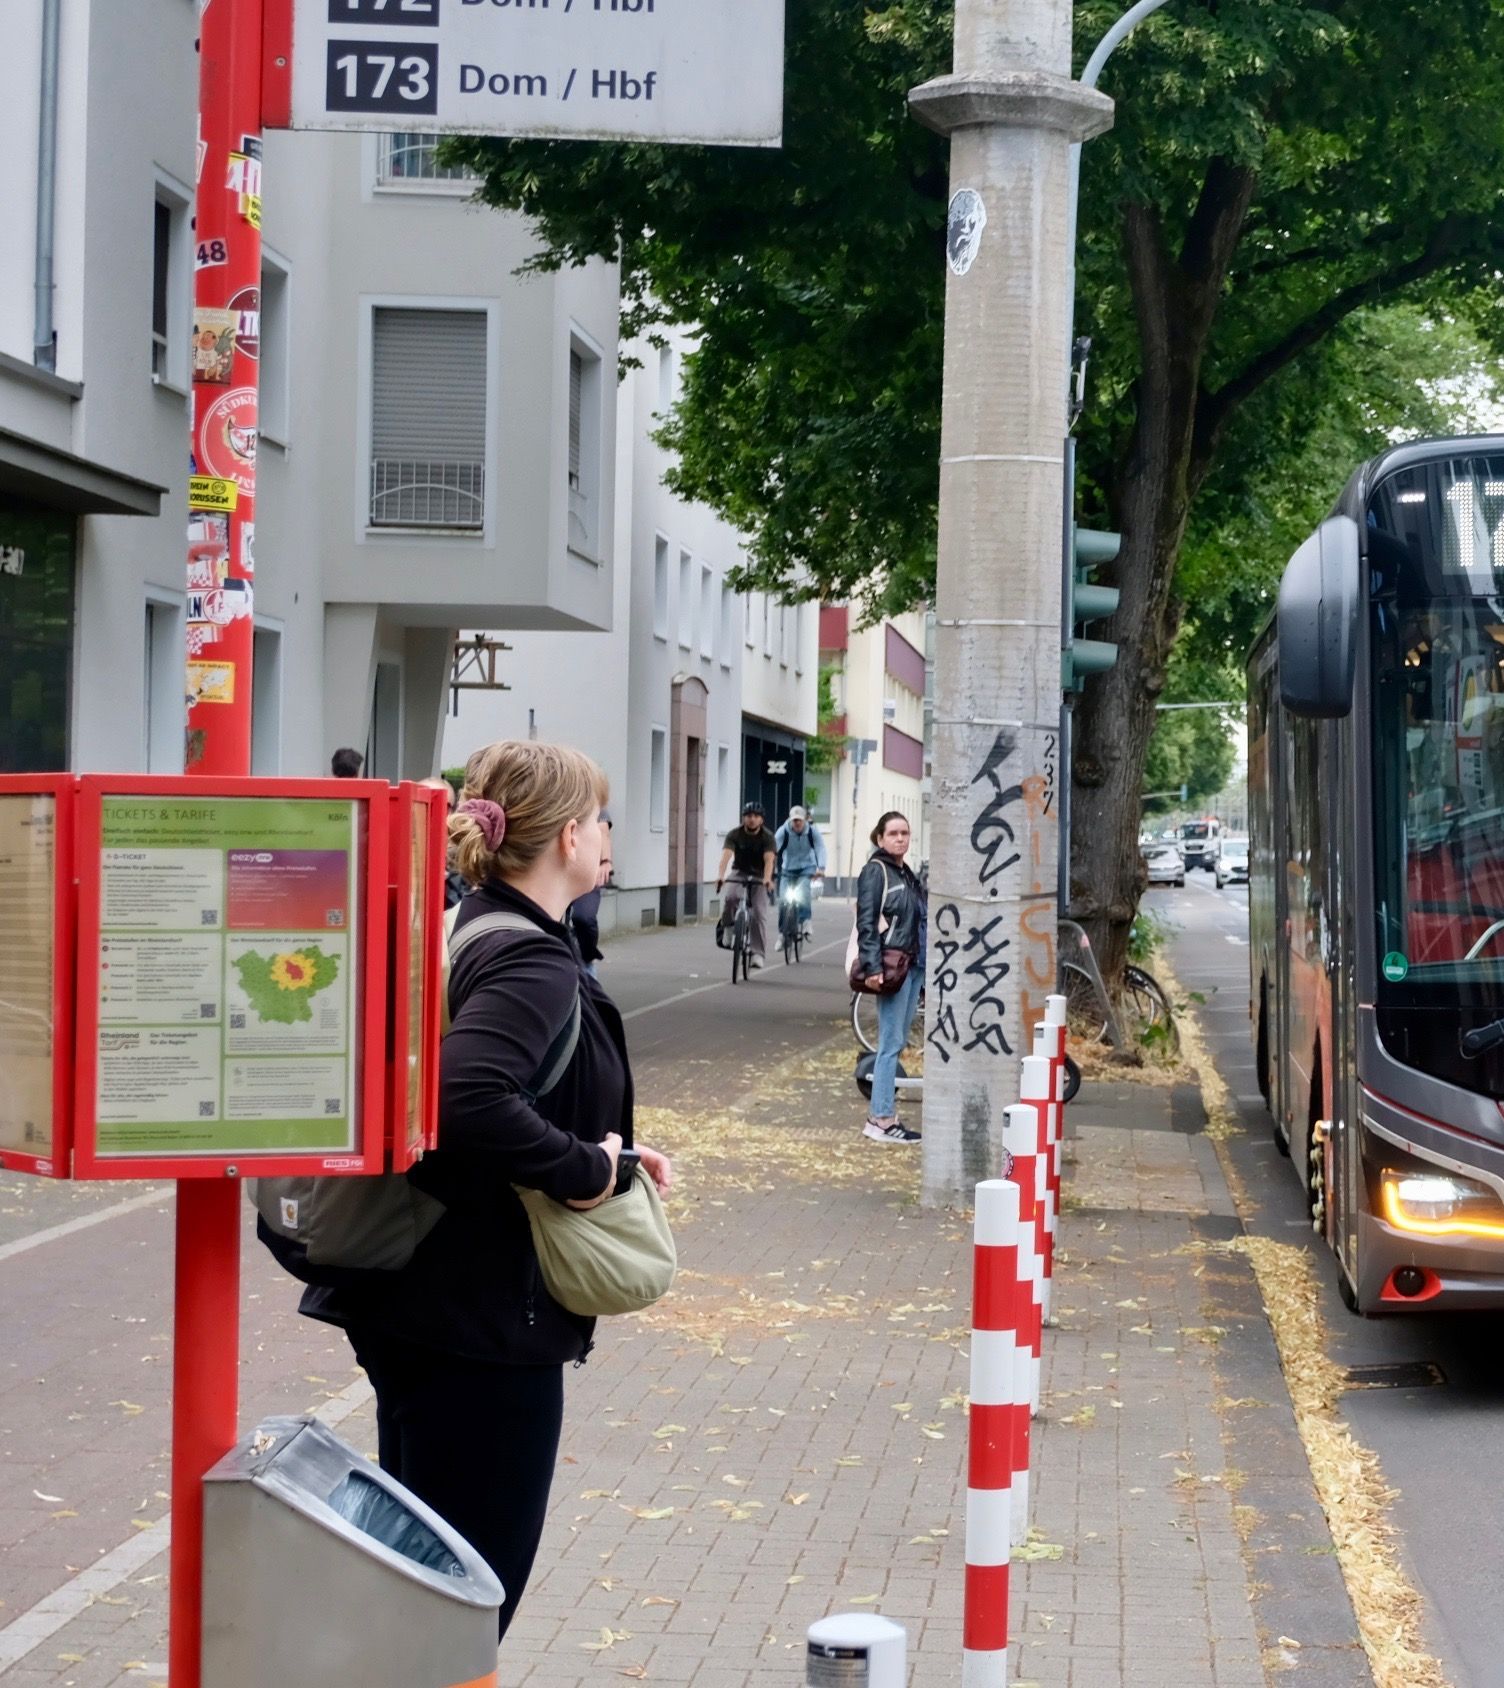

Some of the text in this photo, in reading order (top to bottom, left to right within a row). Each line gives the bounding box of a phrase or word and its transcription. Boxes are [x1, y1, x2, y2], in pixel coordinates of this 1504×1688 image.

[335, 54, 657, 101] 173 Dom / Hbf
[104, 808, 217, 821] TICKETS & TARIFE
[328, 812, 348, 822] Köln
